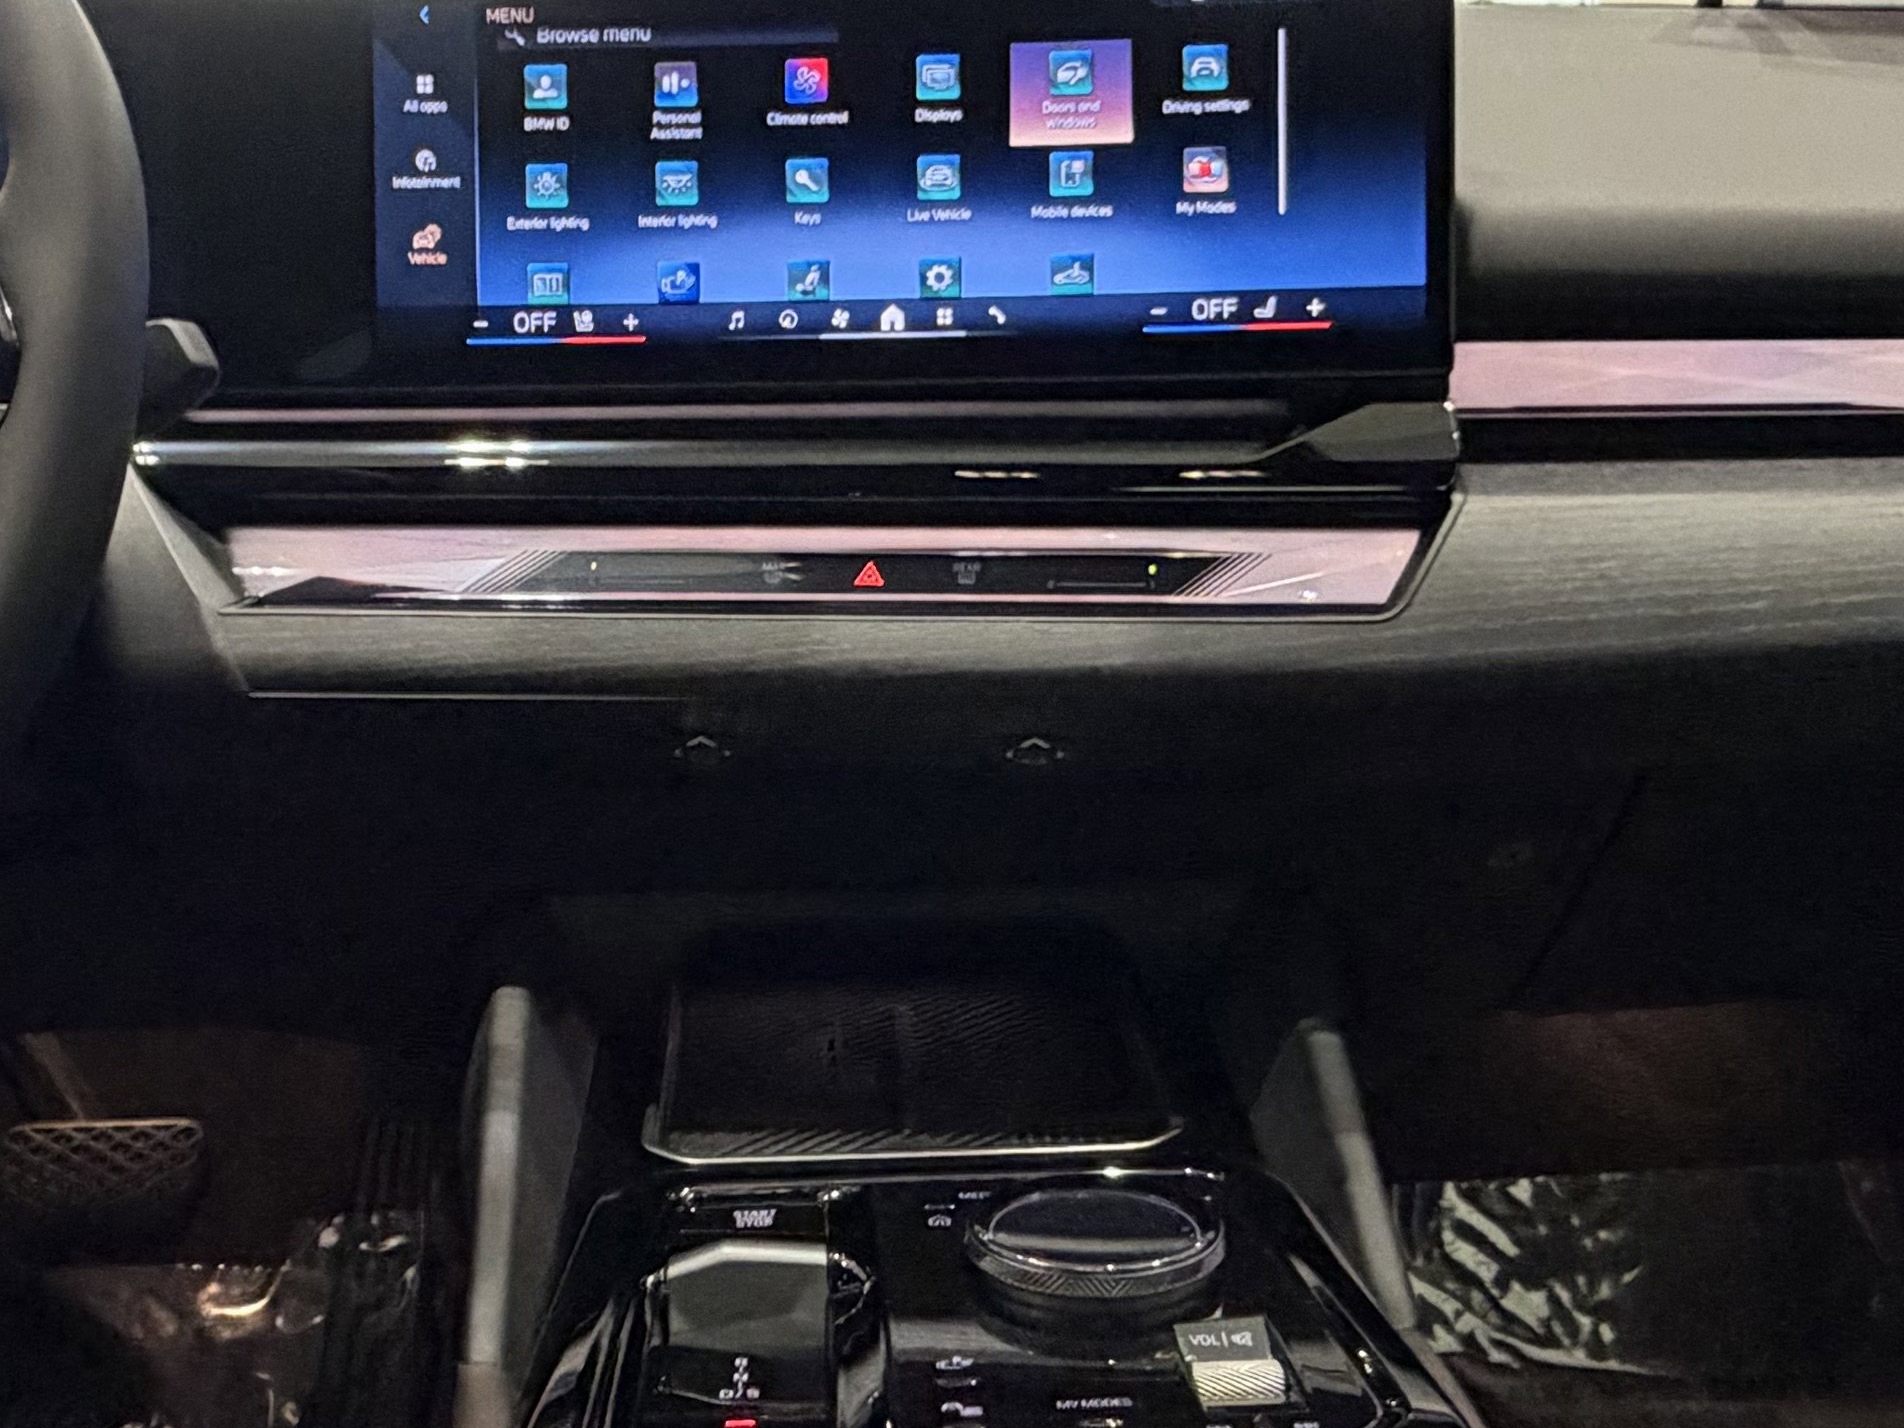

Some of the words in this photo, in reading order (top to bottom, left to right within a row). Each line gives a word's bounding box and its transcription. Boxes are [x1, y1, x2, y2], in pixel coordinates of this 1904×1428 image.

[485, 7, 534, 25] MENU
[536, 28, 600, 45] Browse
[602, 27, 652, 43] menu
[403, 99, 419, 113] All
[420, 100, 448, 115] apps
[1042, 100, 1074, 114] Doors
[1075, 99, 1101, 113] and
[1162, 99, 1204, 115] Driving
[1205, 98, 1251, 114] settings
[652, 110, 702, 125] Personal
[766, 112, 807, 127] Climate
[809, 110, 849, 126] control
[914, 107, 963, 123] Displays
[1044, 113, 1097, 129] windows
[524, 116, 555, 131] BMW
[556, 116, 570, 131] ID
[650, 125, 703, 140] Assistant
[392, 175, 461, 189] Infotainment
[906, 208, 930, 223] Live
[931, 207, 972, 223] Vehicle
[1031, 204, 1070, 219] Mobile
[1071, 203, 1113, 218] devices
[1175, 201, 1195, 217] My
[1196, 200, 1236, 214] Modes
[507, 216, 548, 231] Exterior
[549, 216, 590, 232] lighting
[638, 214, 676, 229] Interior
[677, 213, 719, 231] lighting
[794, 212, 822, 227] Keys
[408, 252, 448, 266] Vehicle
[1191, 297, 1239, 321] OFF
[513, 311, 557, 333] OFF
[733, 1208, 776, 1220] START
[1189, 1333, 1221, 1347] VOL
